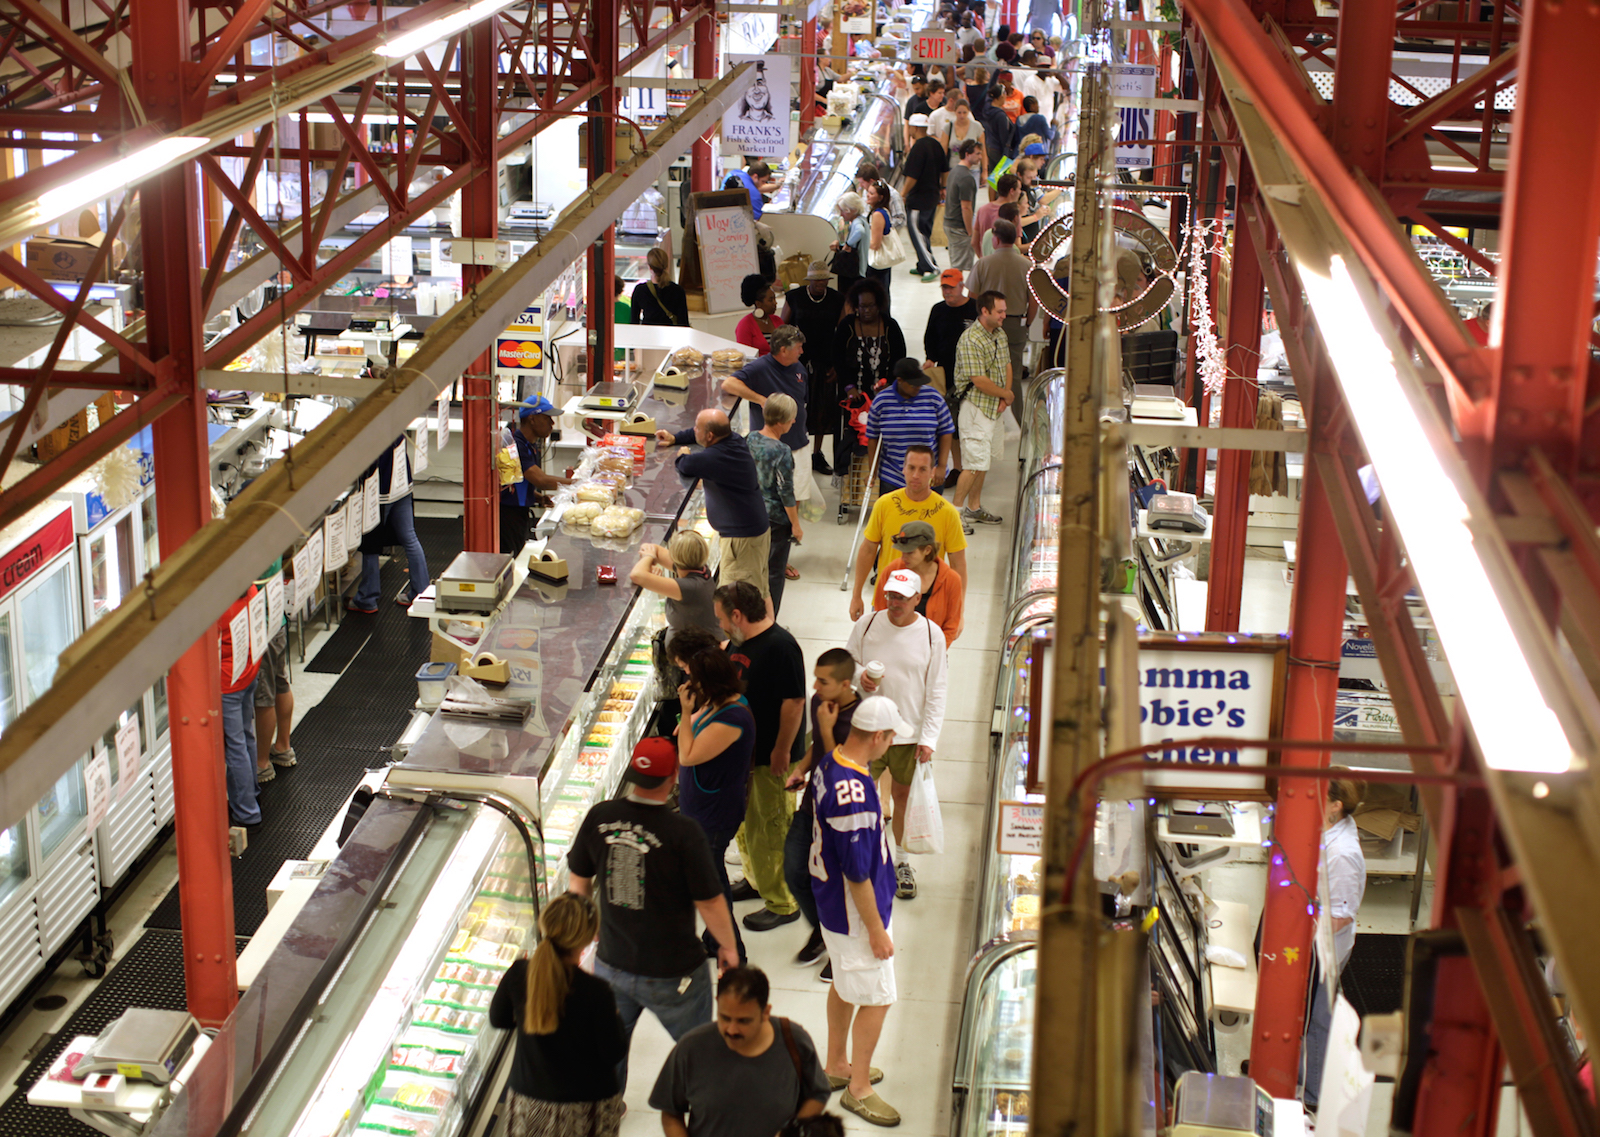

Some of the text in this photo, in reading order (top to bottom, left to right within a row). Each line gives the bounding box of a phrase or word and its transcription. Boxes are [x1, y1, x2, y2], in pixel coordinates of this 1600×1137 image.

[919, 37, 946, 58] EXIT
[732, 125, 781, 136] FRANK'S
[726, 135, 785, 145] Fish & Seafood
[737, 144, 766, 153] Market
[705, 214, 730, 230] Now
[513, 313, 536, 325] ISA
[499, 349, 541, 359] MasterCard
[3, 543, 43, 588] cream
[1138, 668, 1250, 690] mma
[835, 779, 866, 806] 28
